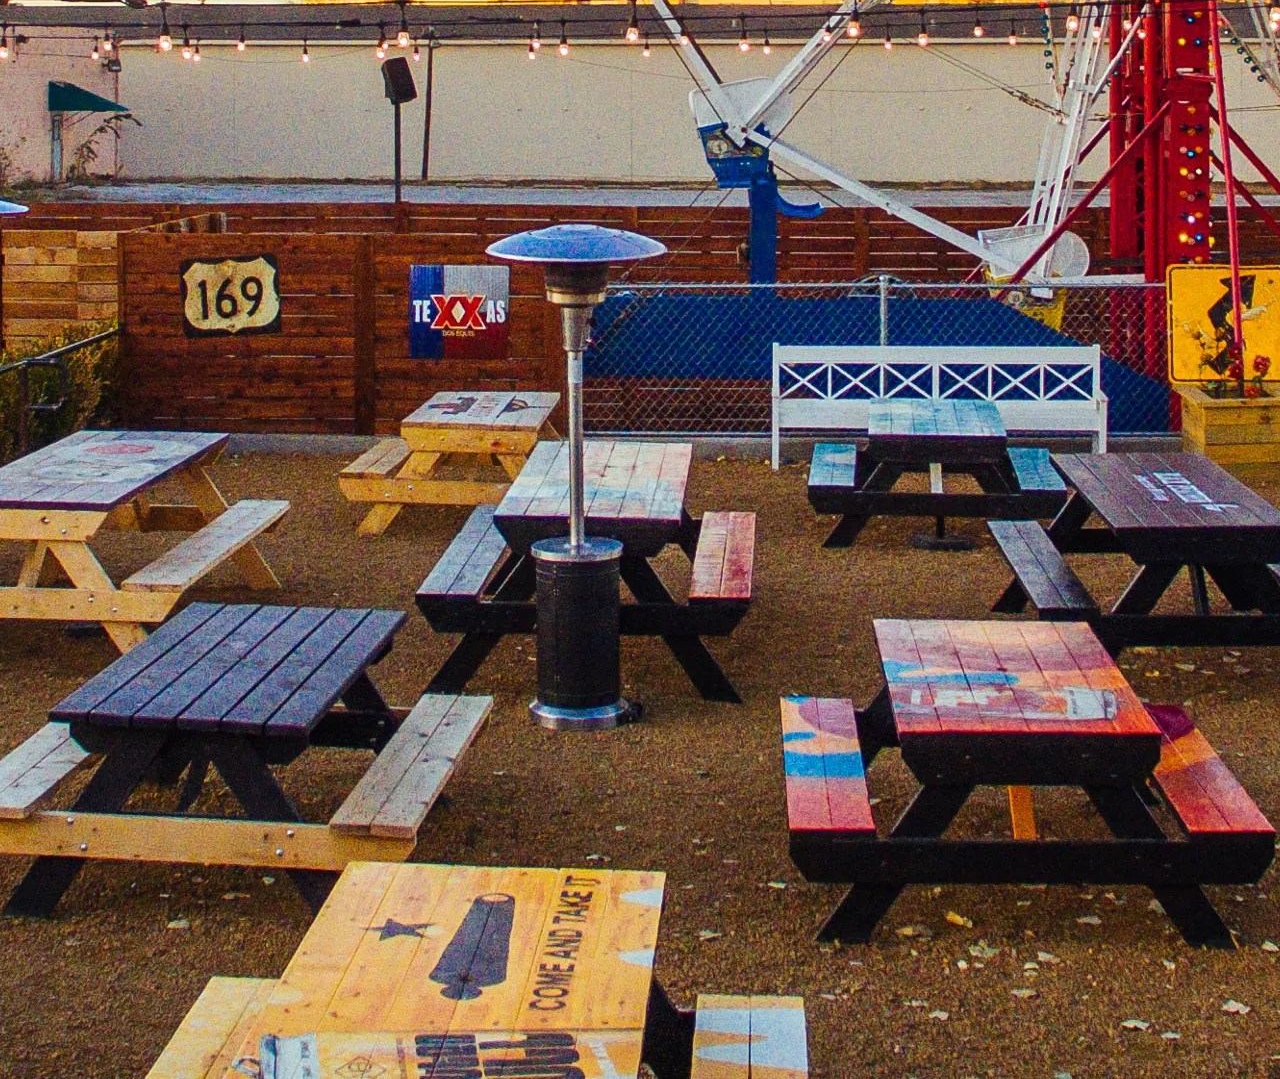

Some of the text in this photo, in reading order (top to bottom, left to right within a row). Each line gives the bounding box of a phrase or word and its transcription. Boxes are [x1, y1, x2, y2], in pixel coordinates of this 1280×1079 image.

[197, 275, 264, 321] 169
[528, 875, 602, 1011] COME AND TAKE IT
